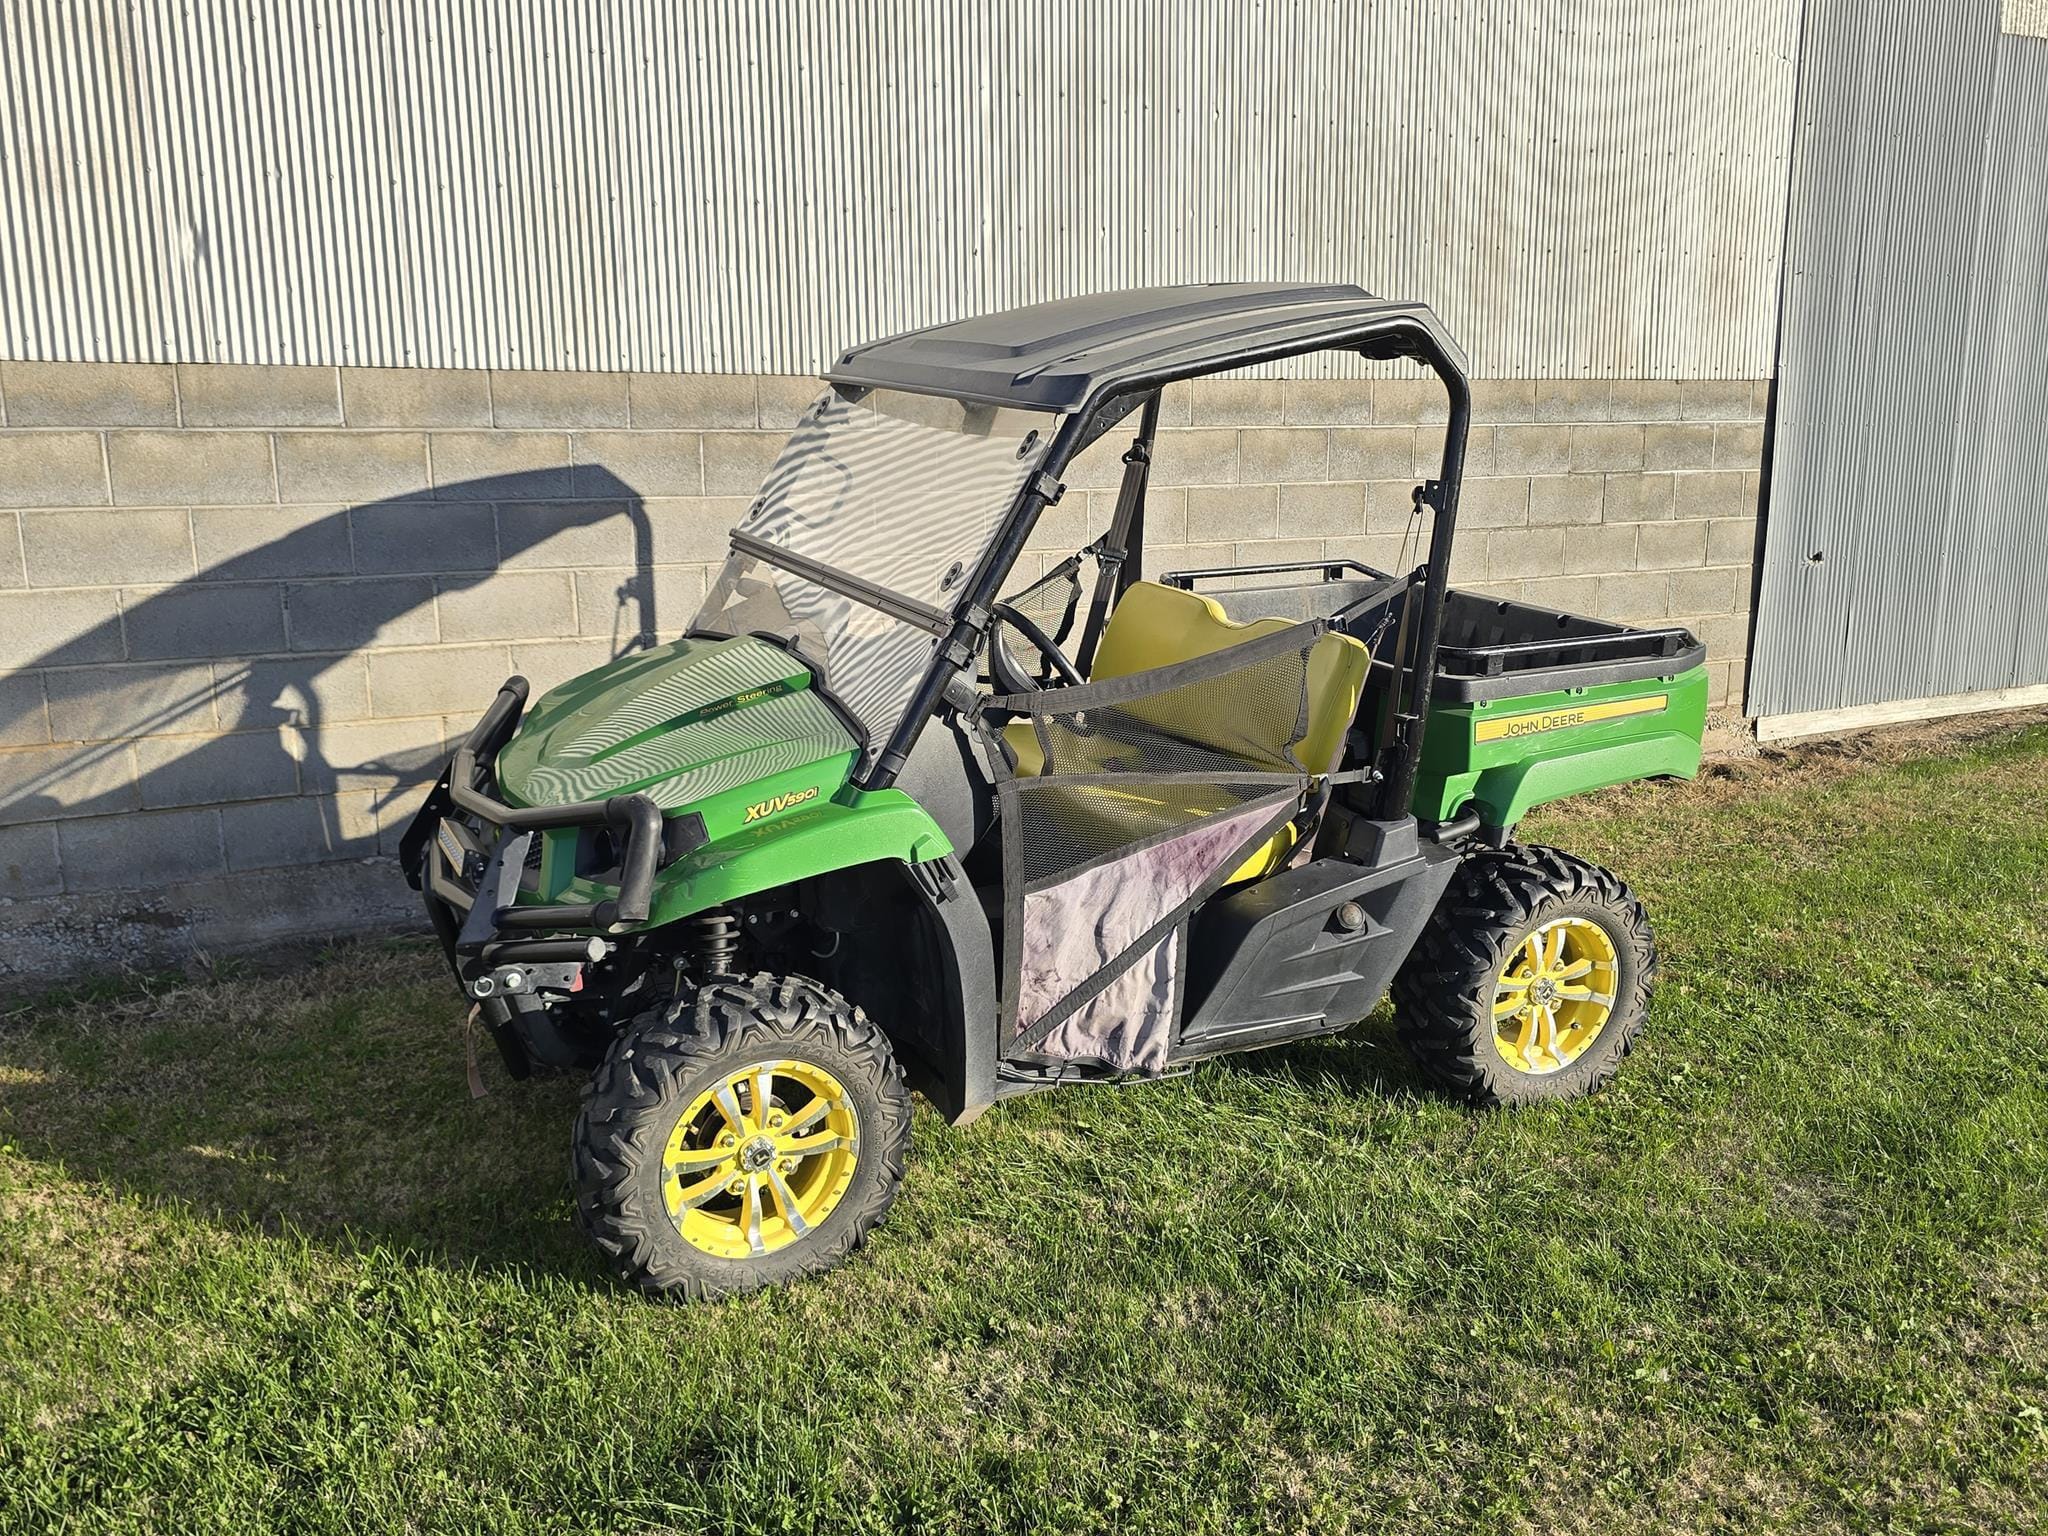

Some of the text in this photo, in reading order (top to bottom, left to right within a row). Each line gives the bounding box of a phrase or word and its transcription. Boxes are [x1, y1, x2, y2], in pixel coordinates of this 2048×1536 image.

[700, 684, 783, 716] Power Steering
[1503, 712, 1584, 737] JOHN DEERE
